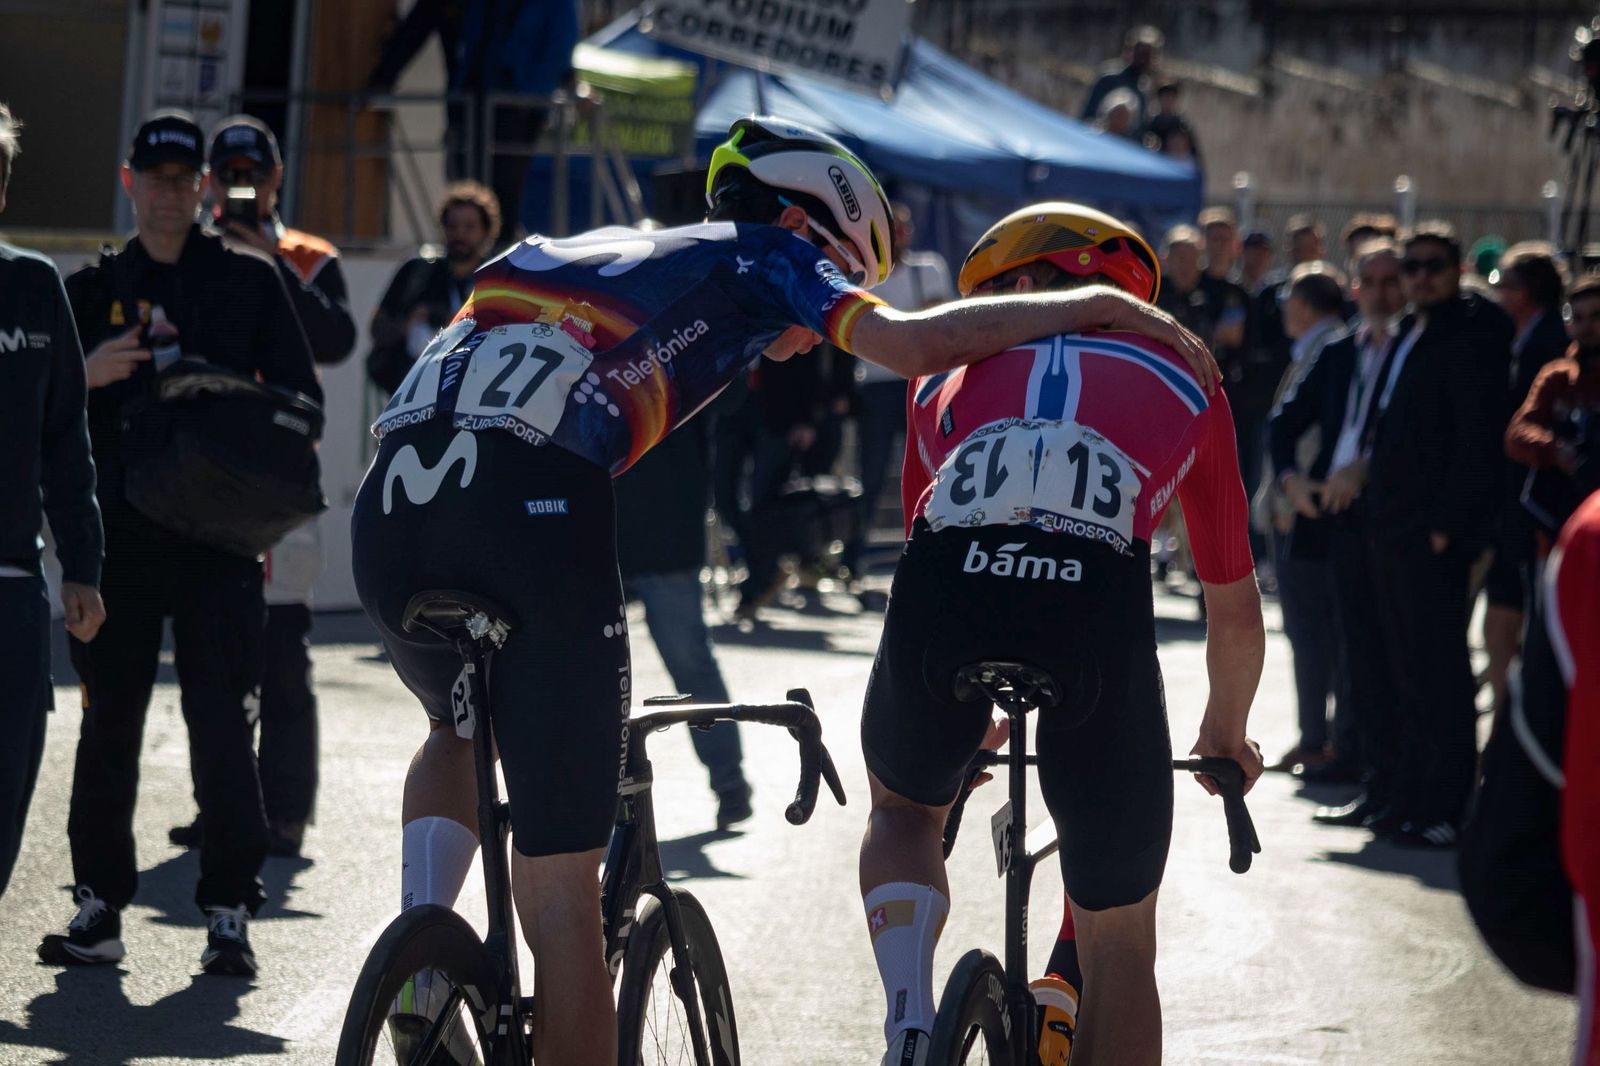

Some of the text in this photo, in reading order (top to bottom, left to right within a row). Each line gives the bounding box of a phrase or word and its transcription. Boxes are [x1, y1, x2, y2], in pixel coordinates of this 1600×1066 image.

[656, 6, 887, 82] CORREDORES
[833, 171, 858, 216] ABUS
[479, 342, 565, 409] 27
[606, 319, 709, 390] Telefónica
[378, 406, 435, 439] UROSPORT
[464, 415, 544, 446] EUROSPORT
[1067, 441, 1122, 519] 13
[528, 500, 566, 514] GOBIK
[1043, 513, 1127, 553] EUROSPORT
[453, 681, 469, 726] 27
